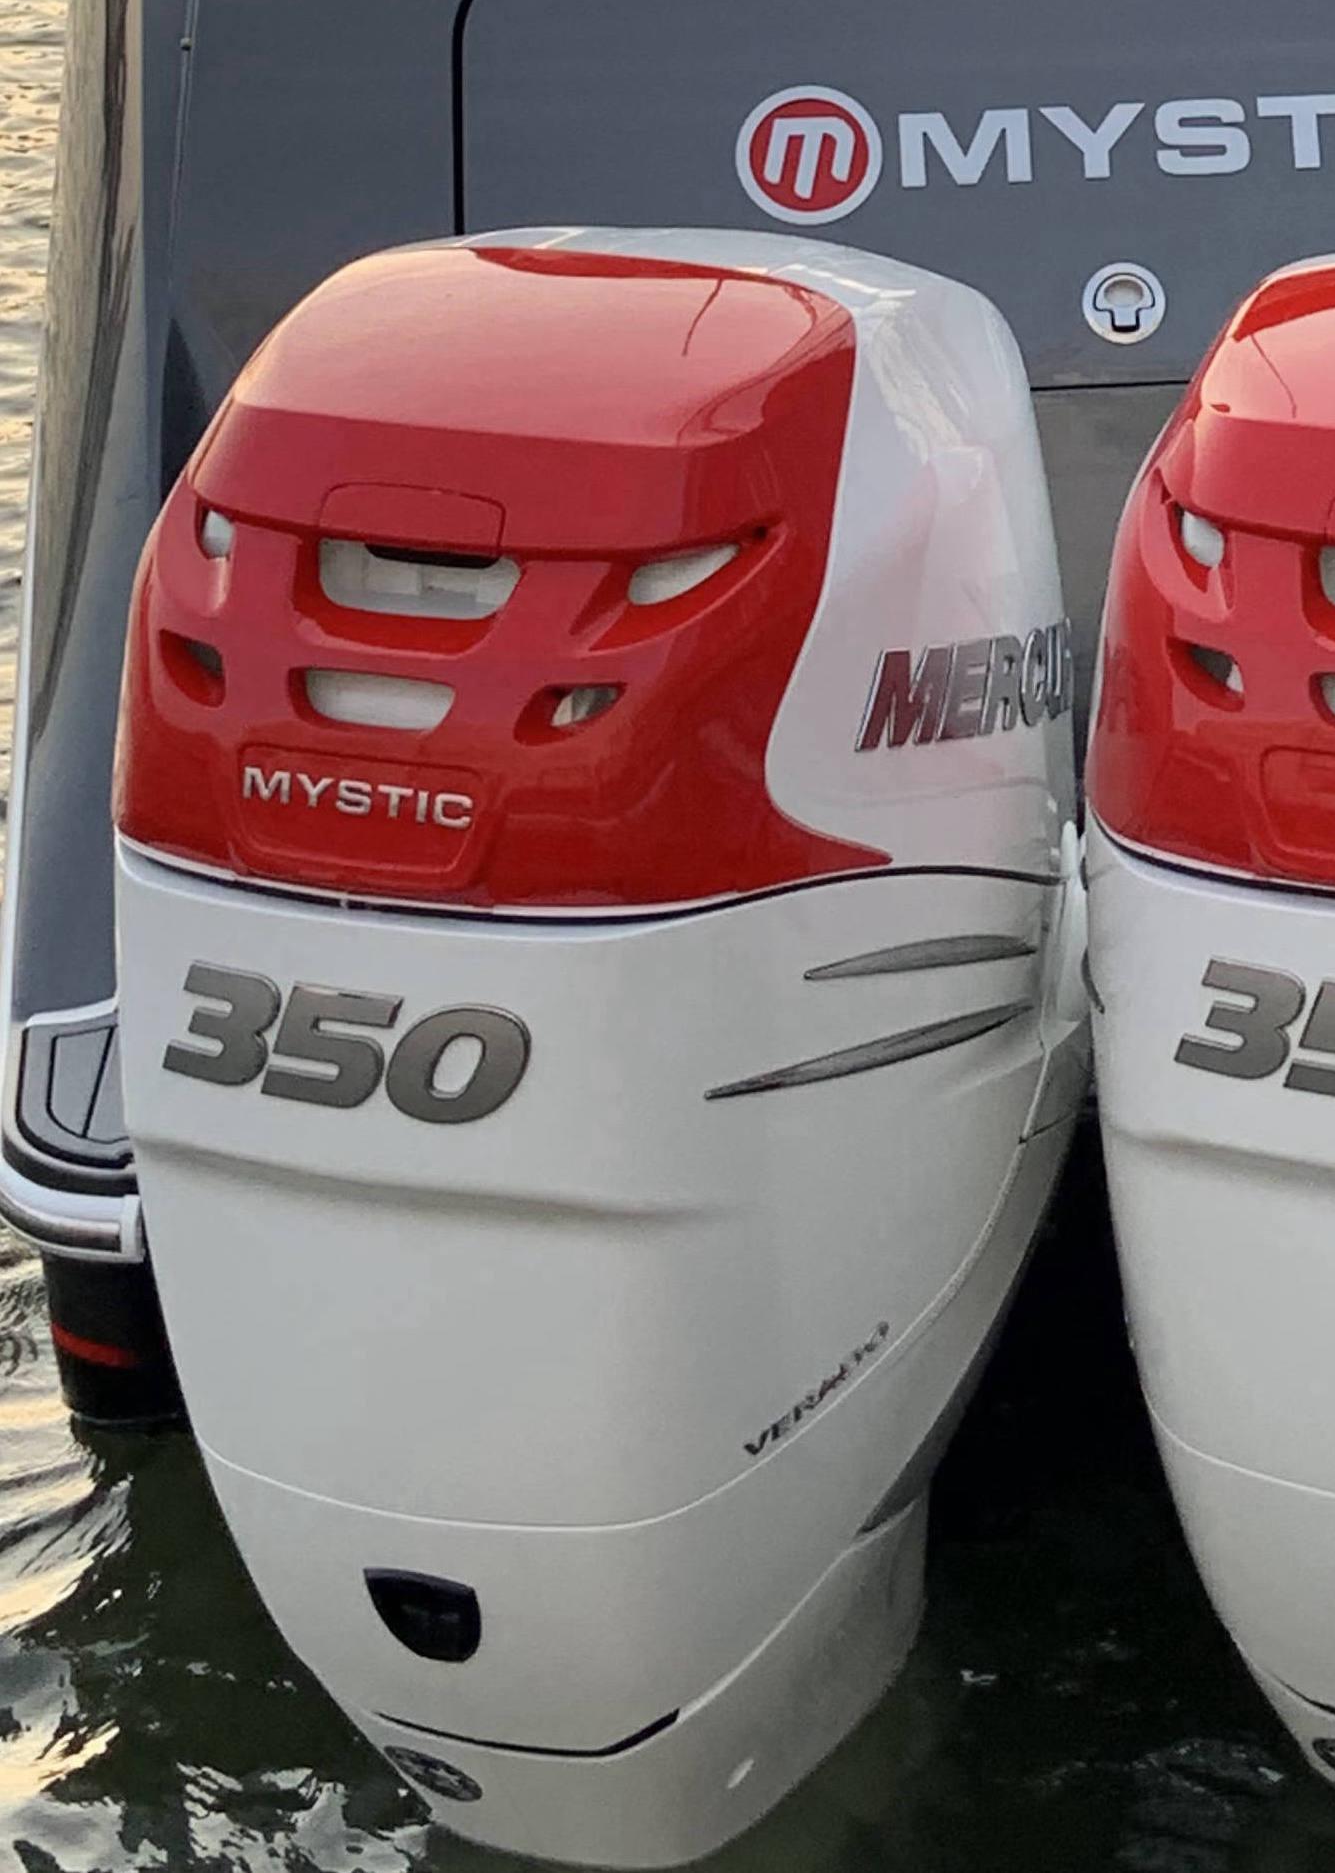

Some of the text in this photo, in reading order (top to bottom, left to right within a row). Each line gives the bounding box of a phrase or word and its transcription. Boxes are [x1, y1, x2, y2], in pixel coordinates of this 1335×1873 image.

[854, 617, 1073, 753] MERCU
[241, 765, 475, 829] MYSTIC
[162, 959, 533, 1125] 350
